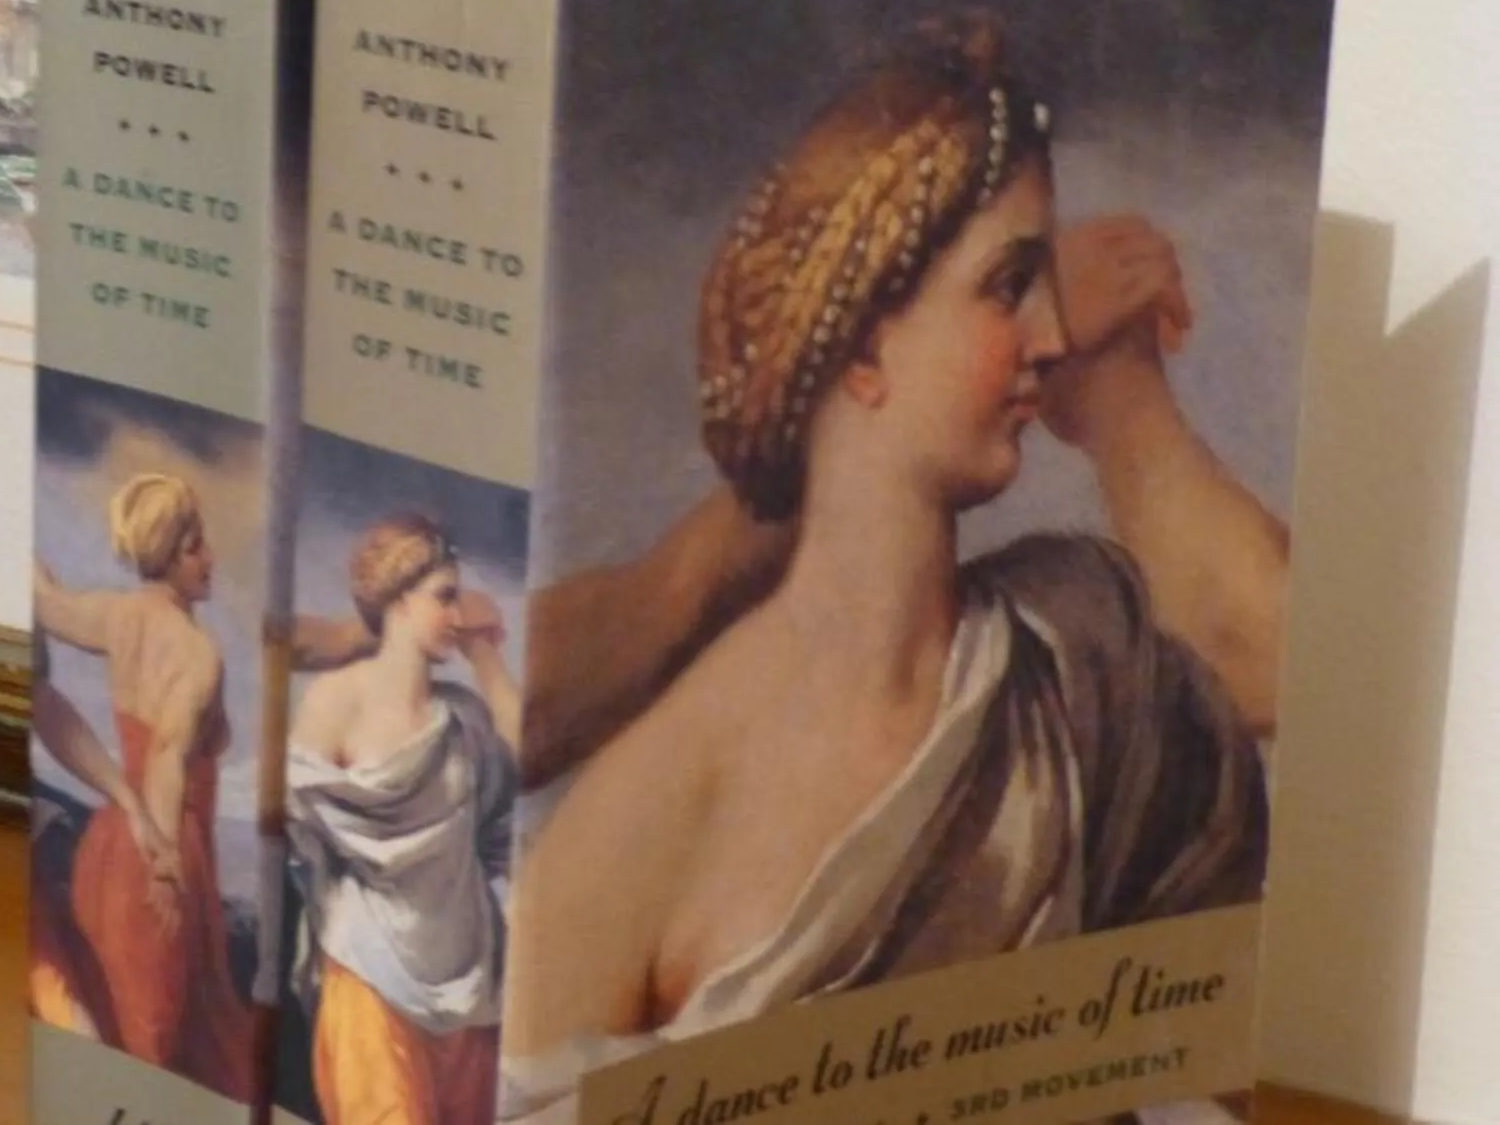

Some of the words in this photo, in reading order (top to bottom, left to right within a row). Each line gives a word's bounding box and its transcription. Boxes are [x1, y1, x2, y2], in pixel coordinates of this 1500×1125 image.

[93, 51, 216, 93] POWELL
[353, 29, 510, 83] ANTHONY
[361, 90, 497, 140] POWELL
[62, 168, 81, 189] A
[93, 172, 193, 214] DANCE
[204, 193, 241, 223] TO
[69, 222, 127, 253] THE
[139, 236, 233, 278] MUSIC
[327, 210, 348, 234] A
[358, 217, 468, 266] DANCE
[479, 247, 525, 279] TO
[90, 283, 130, 308] OF
[140, 292, 211, 329] TIME
[331, 268, 393, 306] THE
[403, 287, 512, 336] MUSIC
[351, 333, 393, 361] OF
[404, 347, 484, 389] TIME
[675, 1078, 800, 1125] dance
[811, 1040, 855, 1096] to
[864, 1014, 933, 1081] the
[943, 994, 1067, 1062] music
[1077, 956, 1134, 1041] of
[1130, 965, 1226, 1019] time
[950, 1086, 1011, 1121] 3RD
[1019, 1046, 1192, 1103] MOVEMENT
